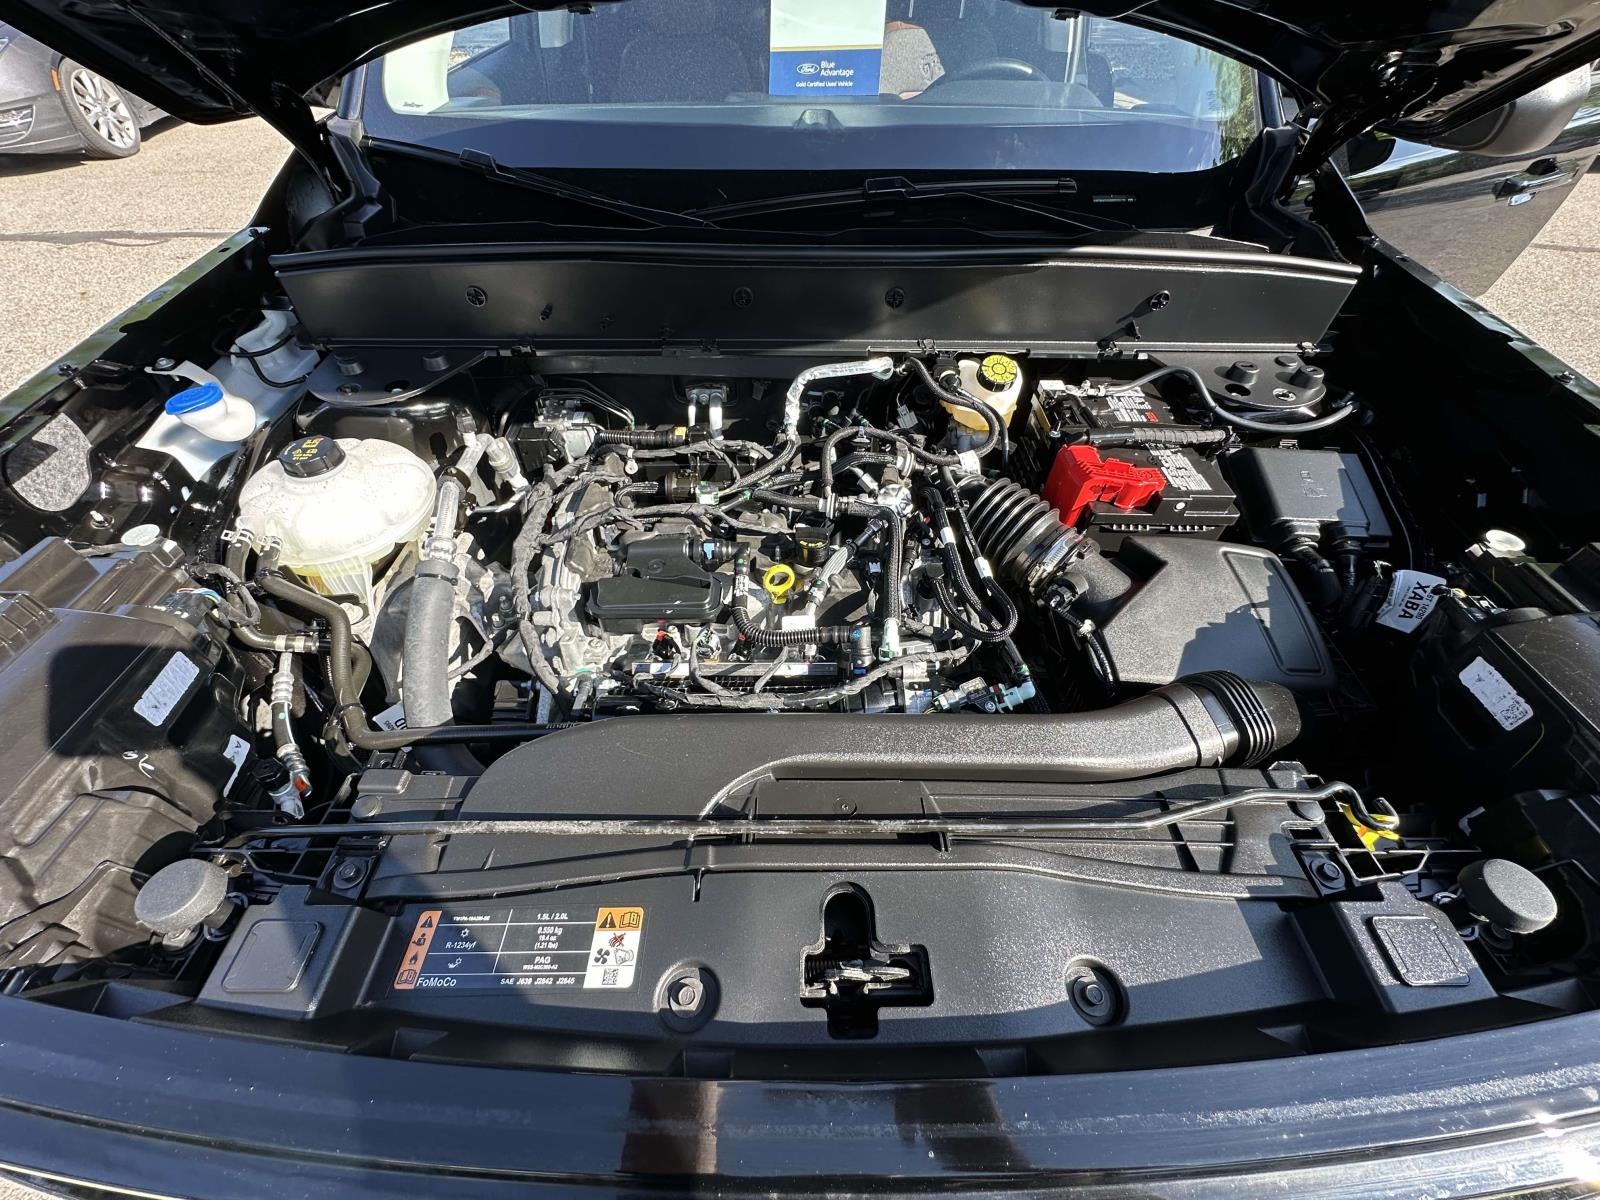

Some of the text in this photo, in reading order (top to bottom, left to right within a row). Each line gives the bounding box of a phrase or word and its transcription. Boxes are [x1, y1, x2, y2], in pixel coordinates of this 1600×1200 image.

[820, 61, 835, 69] Blue
[820, 69, 854, 77] Advantage
[1398, 581, 1431, 619] XABA
[538, 926, 563, 935] 0.550 kg
[445, 941, 477, 950] R-1234yf
[534, 956, 551, 964] PAG
[416, 977, 457, 987] FoMoCo
